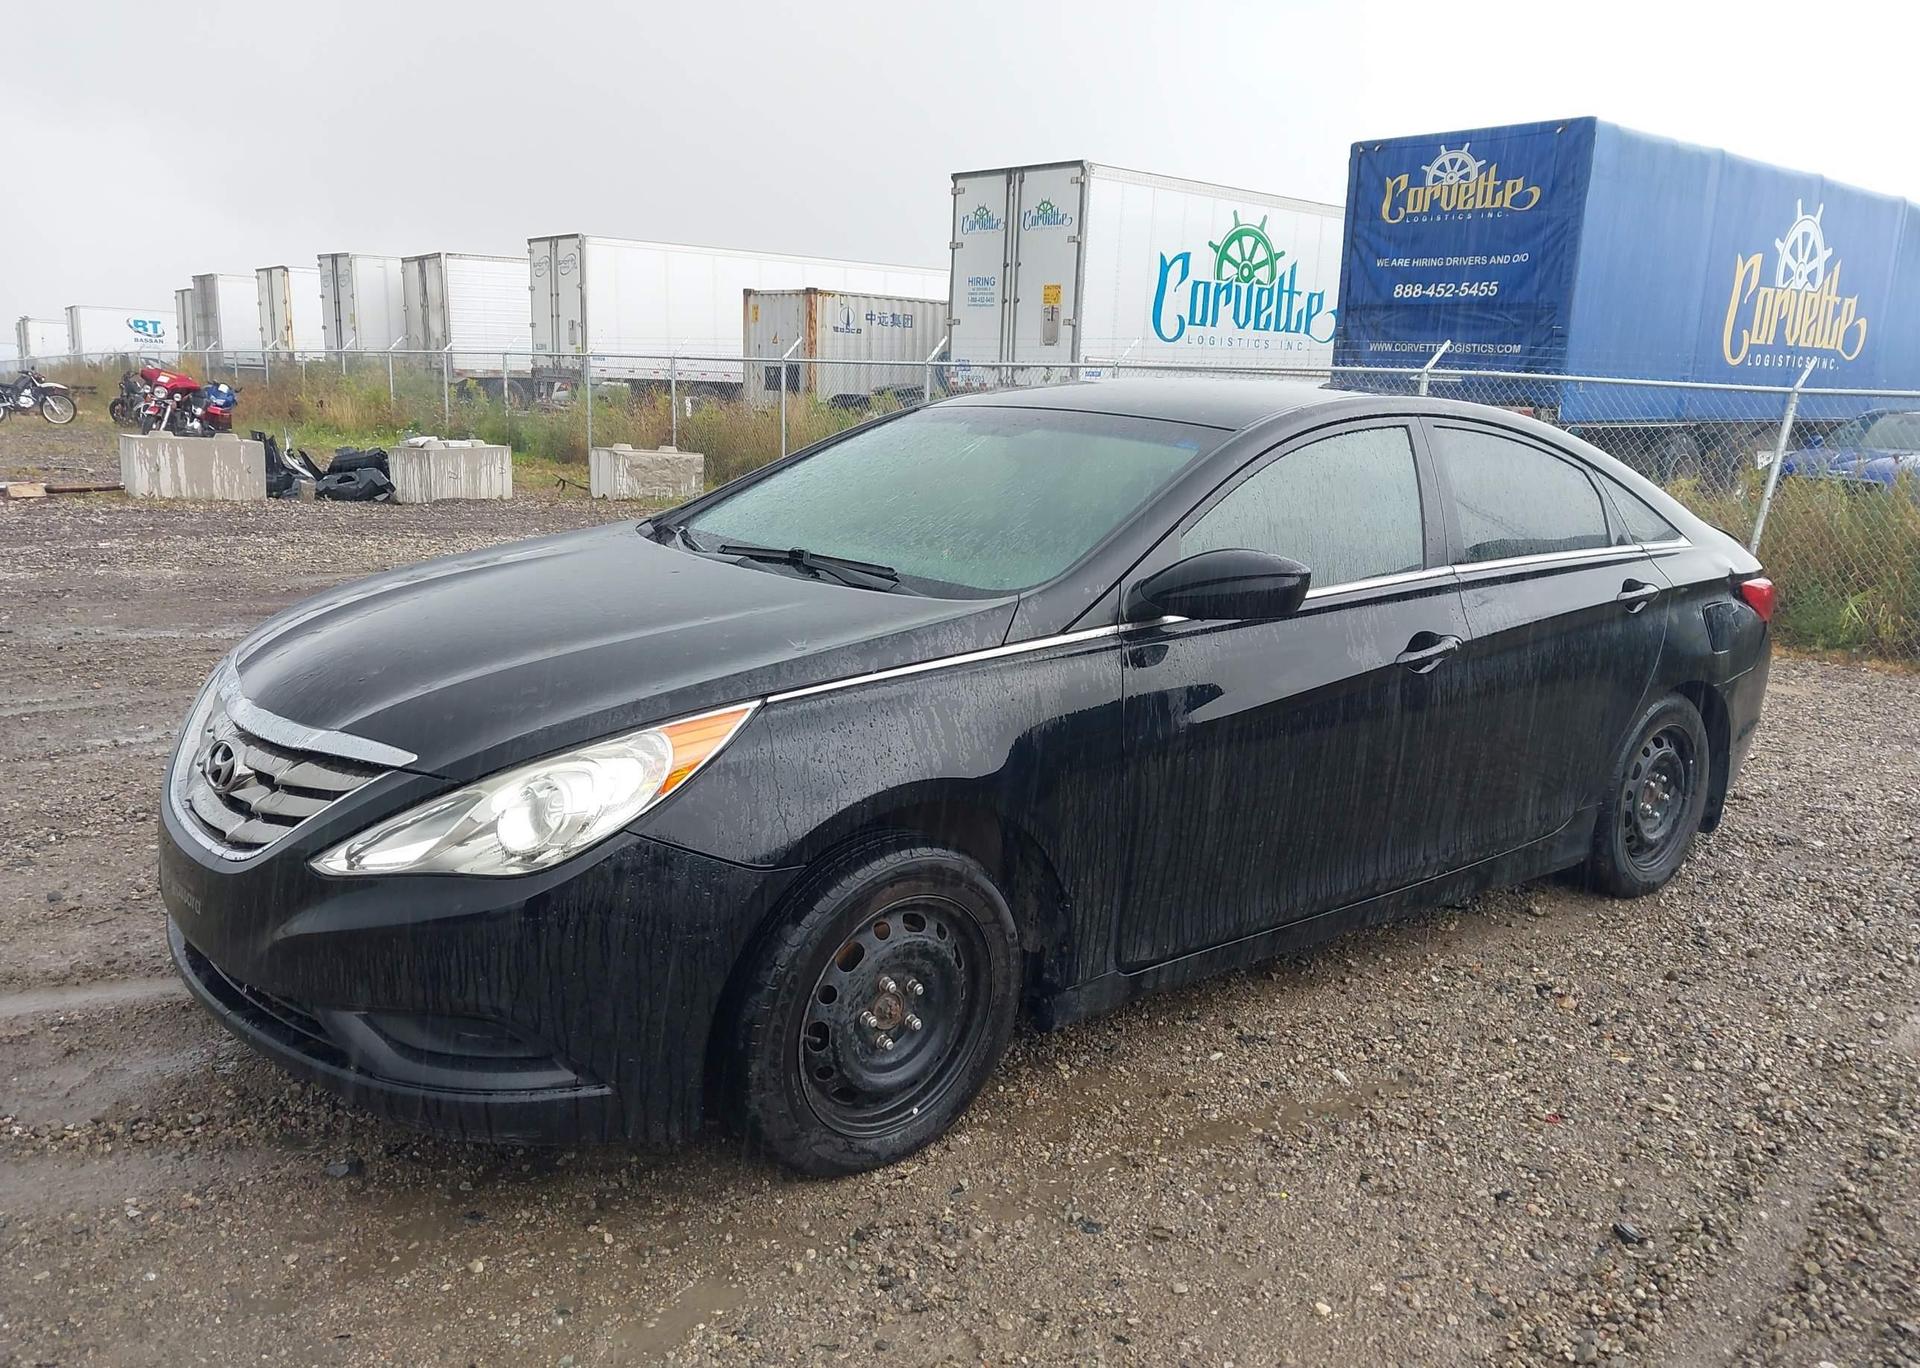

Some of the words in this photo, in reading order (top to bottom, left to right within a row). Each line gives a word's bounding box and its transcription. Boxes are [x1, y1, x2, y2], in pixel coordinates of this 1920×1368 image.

[1382, 163, 1541, 224] Corvette
[961, 213, 1006, 236] Corvette
[1022, 207, 1073, 232] Corvette
[1406, 213, 1472, 223] LOGISTICS
[1481, 211, 1510, 219] INC.
[1376, 258, 1390, 268] WE
[1391, 258, 1410, 267] ARE
[1412, 256, 1444, 267] HIRING
[1445, 255, 1487, 266] DRIVERS
[1489, 254, 1511, 265] AND
[1512, 252, 1529, 263] O/O
[967, 276, 996, 287] HIRING
[1393, 281, 1498, 298] 888-452-5455
[1152, 251, 1337, 343] Corvette
[1723, 253, 1867, 366] Corvette
[865, 310, 913, 329] 中远集团
[1187, 335, 1270, 350] LOGISTICS
[1280, 341, 1311, 352] INC.
[1369, 342, 1521, 354] WWW.CORVETTEOGISTICS.COM
[1747, 354, 1812, 370] LOGISTICS
[1816, 356, 1840, 370] INC.
